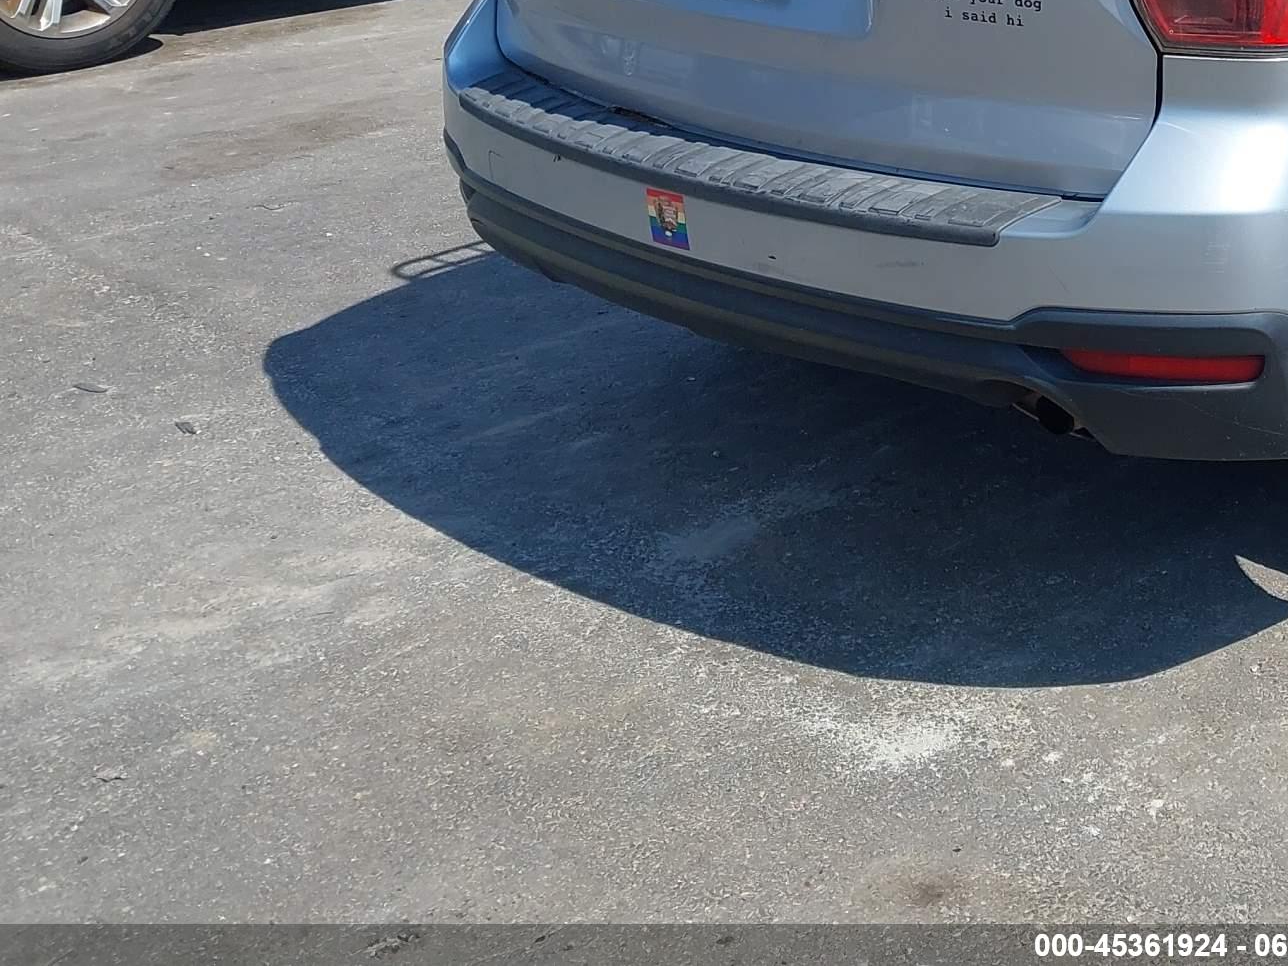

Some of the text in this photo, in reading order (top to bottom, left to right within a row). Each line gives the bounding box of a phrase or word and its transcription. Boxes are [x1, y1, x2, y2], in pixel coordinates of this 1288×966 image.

[944, 7, 1024, 27] i said hi
